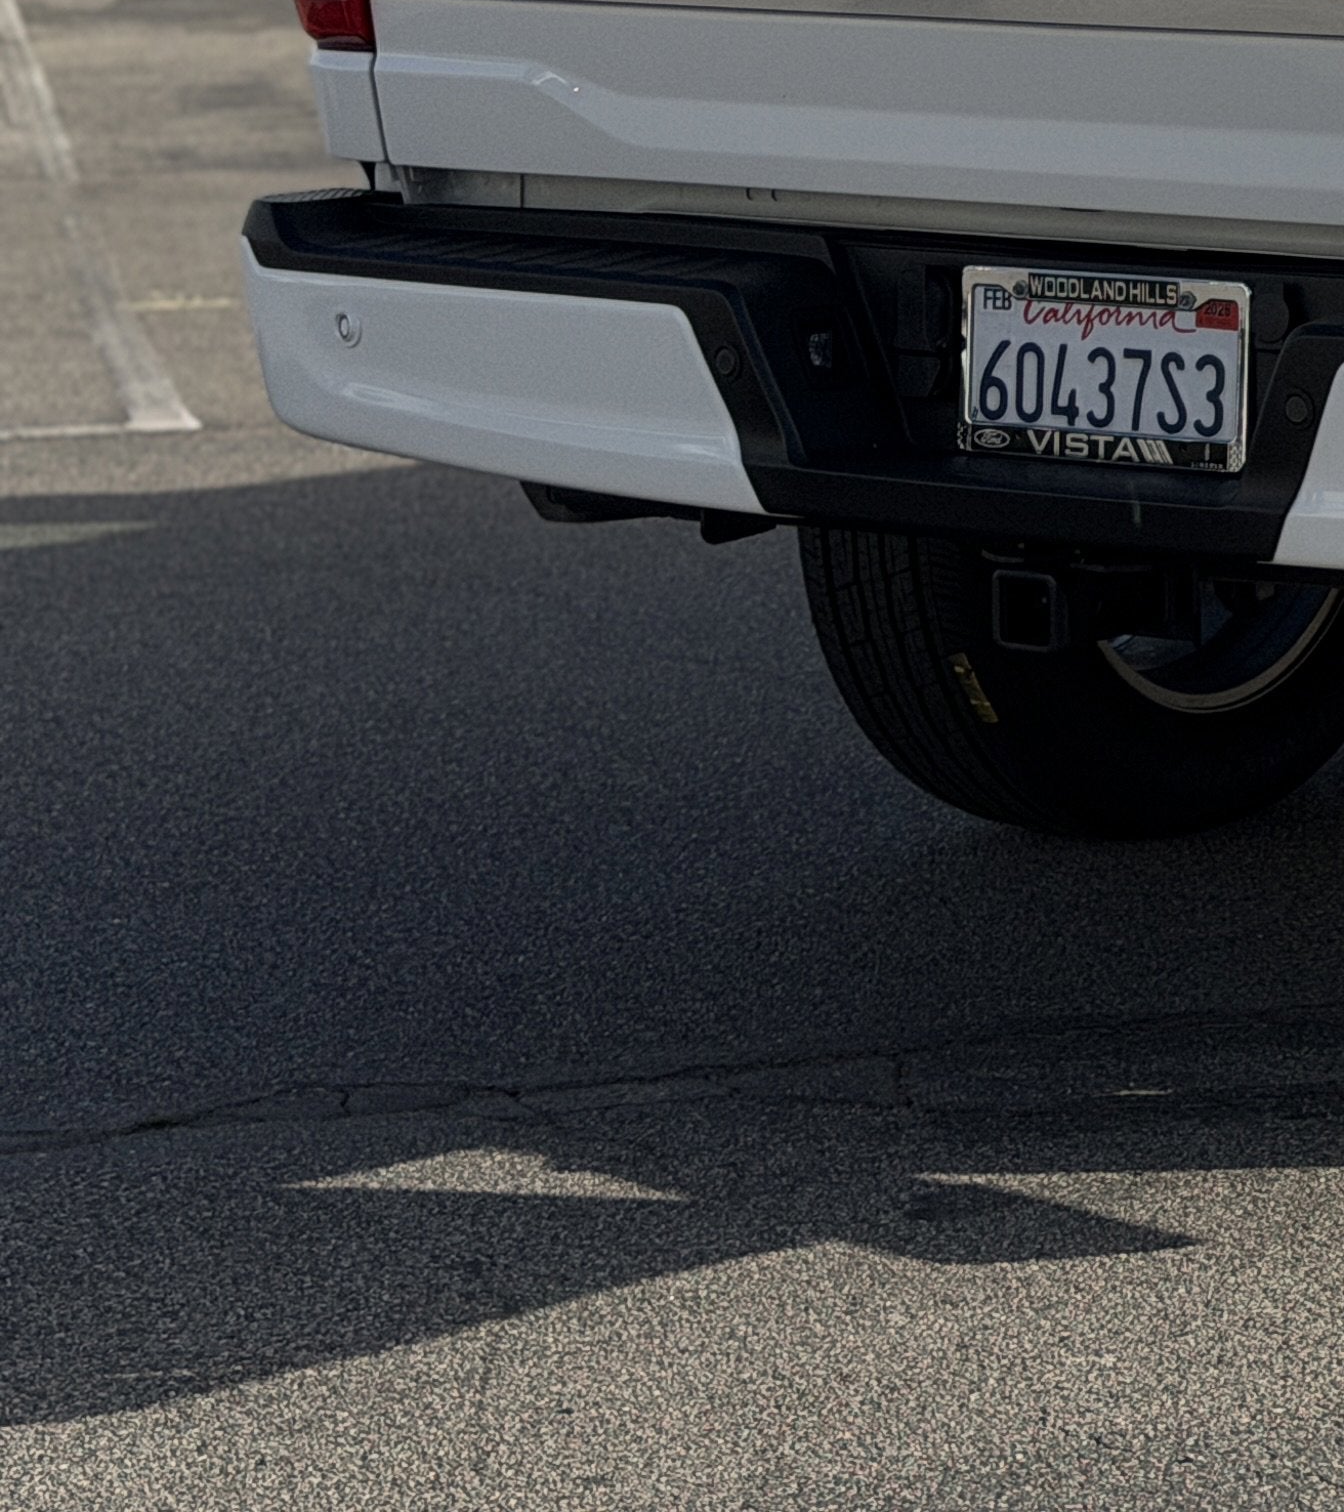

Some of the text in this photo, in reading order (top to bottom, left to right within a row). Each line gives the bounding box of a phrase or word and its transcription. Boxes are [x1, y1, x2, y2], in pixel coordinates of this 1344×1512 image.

[983, 287, 1013, 311] FEB
[1029, 273, 1178, 305] WOODLAND HILLS
[1022, 299, 1197, 341] California
[978, 340, 1226, 437] 60437S3
[1026, 429, 1141, 463] VISTA
